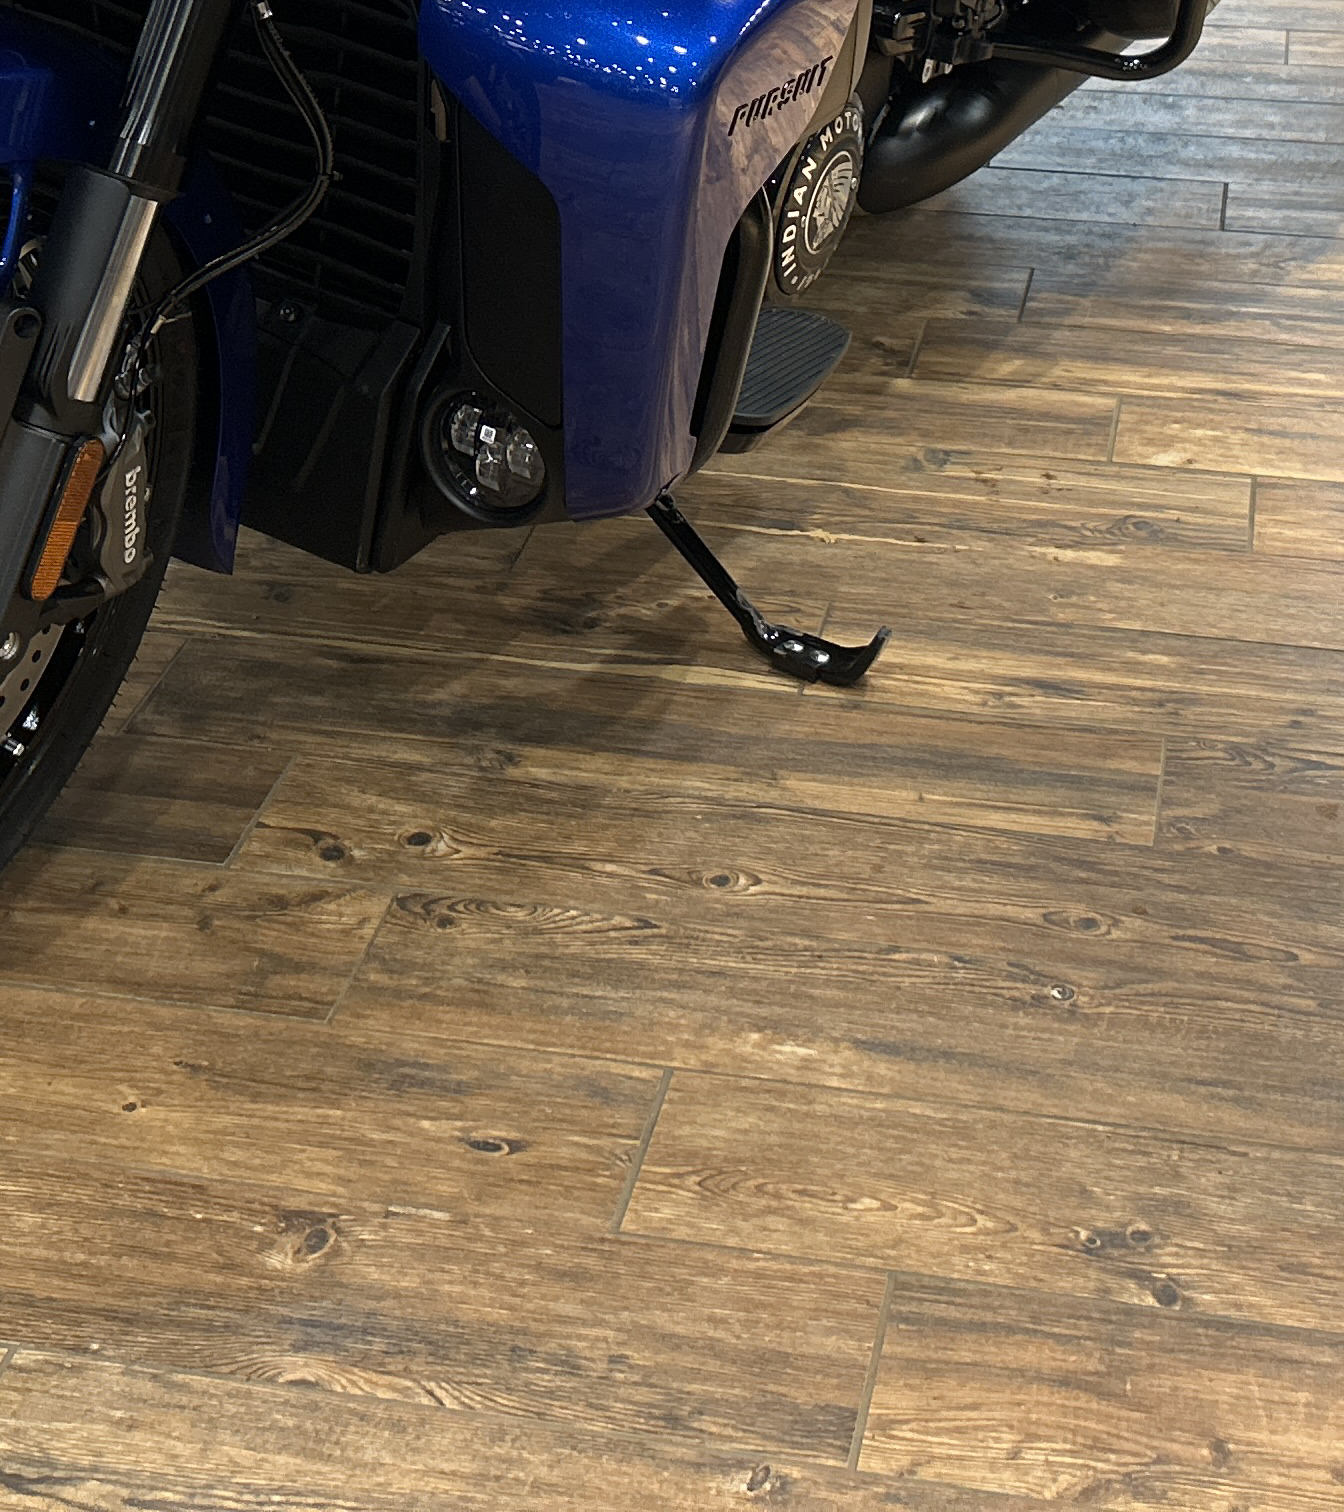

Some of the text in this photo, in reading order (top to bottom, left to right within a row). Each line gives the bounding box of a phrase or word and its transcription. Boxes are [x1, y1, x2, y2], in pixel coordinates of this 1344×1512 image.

[727, 54, 834, 137] PURSUIT
[781, 156, 818, 278] INDIAN
[124, 465, 142, 564] brembo
